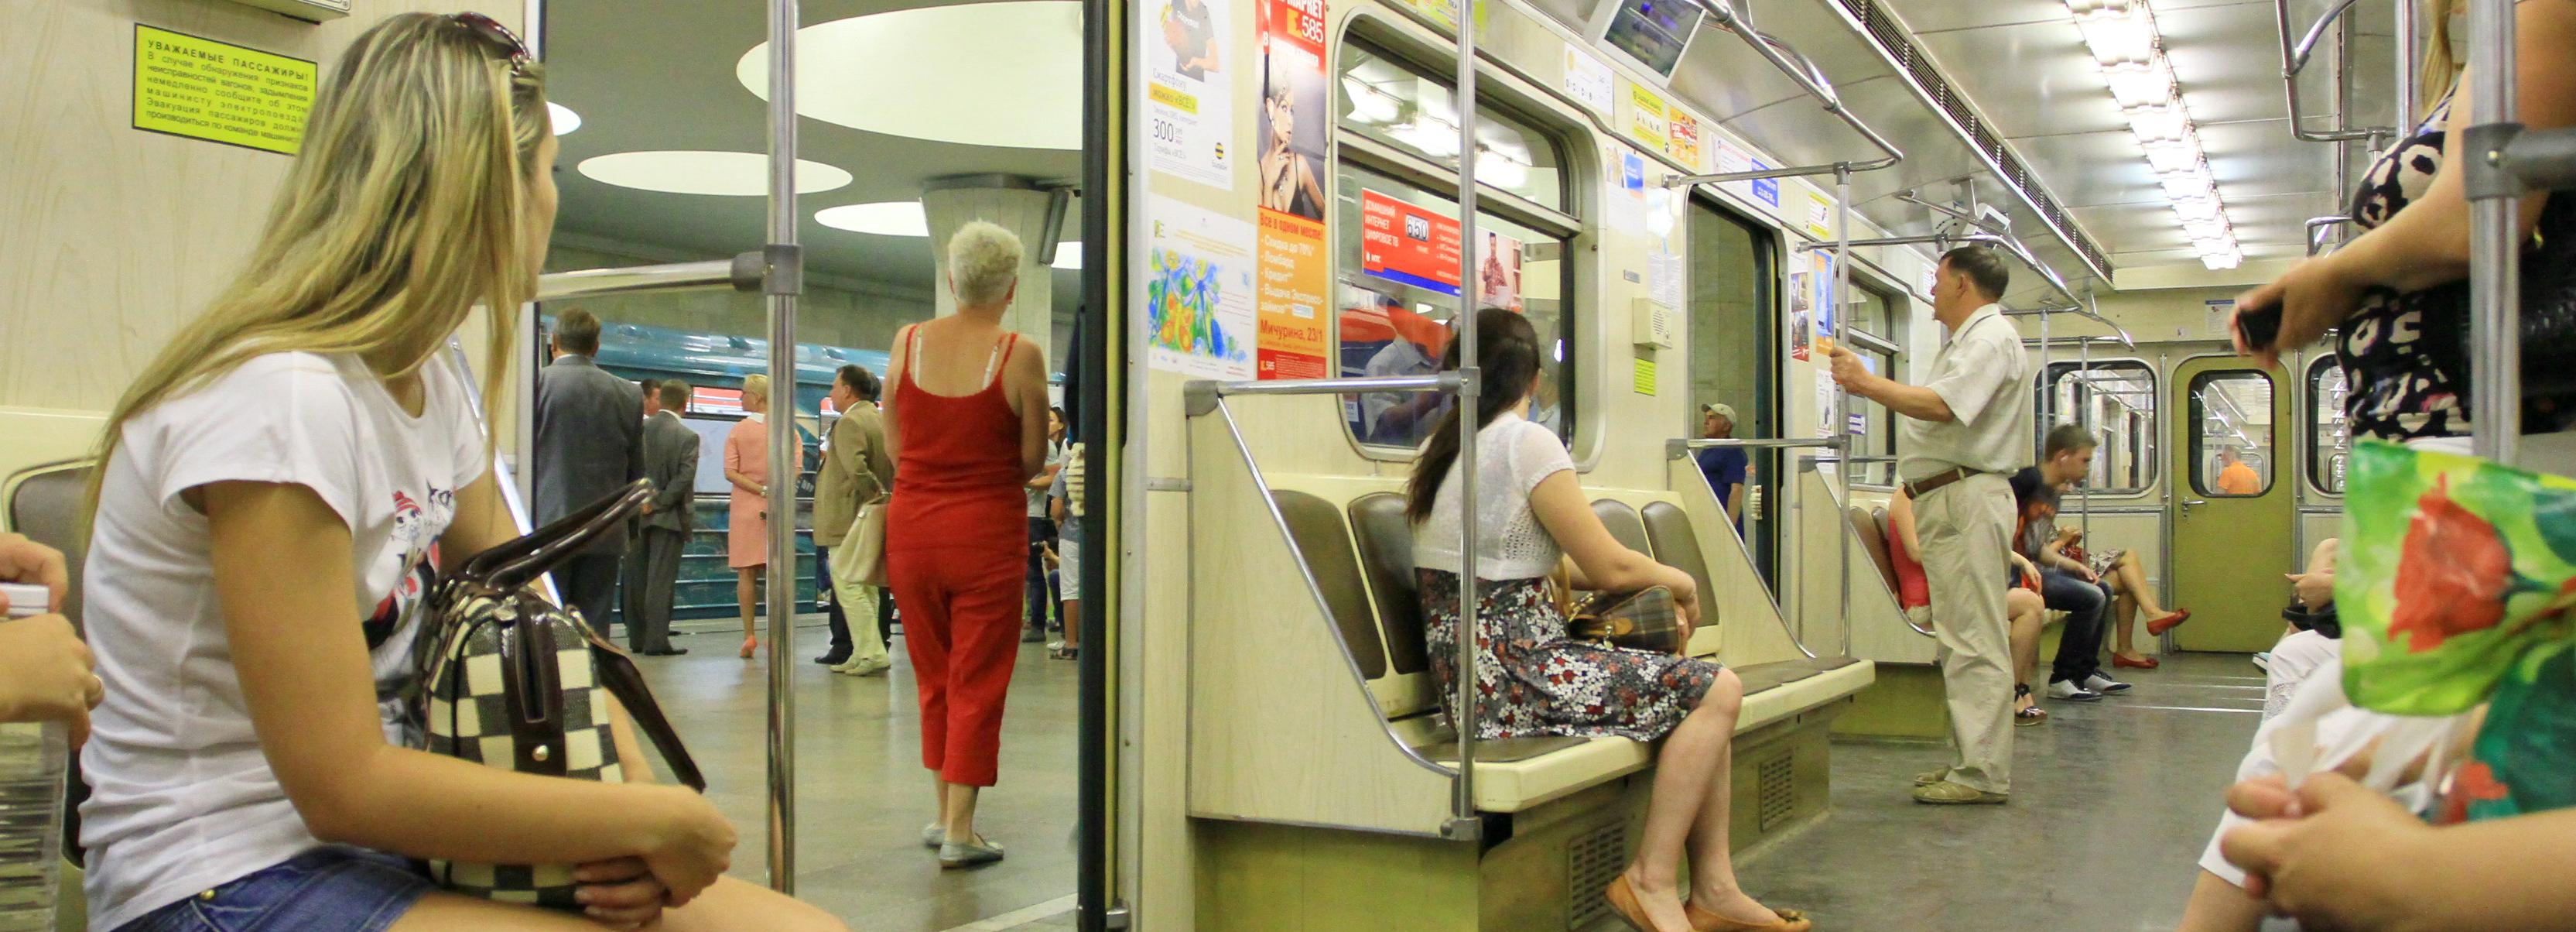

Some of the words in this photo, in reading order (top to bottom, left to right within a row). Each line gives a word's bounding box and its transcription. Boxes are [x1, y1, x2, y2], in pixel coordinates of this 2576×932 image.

[1302, 15, 1324, 43] 585
[148, 40, 224, 63] УВАЖАЕМЫЕ
[233, 59, 308, 81] ПАССАЖИРЫ!
[148, 65, 216, 83] неисправностей
[162, 56, 193, 68] случае
[201, 64, 259, 81] обнаружения
[266, 77, 308, 92] признаков
[147, 88, 211, 107] машинисту
[148, 77, 207, 93] немедленно
[216, 89, 261, 105] сообщите
[269, 99, 279, 108] об
[147, 98, 200, 114] Эвакуация
[209, 110, 265, 127] пассажиров
[147, 110, 210, 127] производиться
[212, 121, 222, 130] по
[224, 124, 258, 137] команде
[1153, 118, 1174, 142] 300
[1407, 217, 1427, 240] 650
[1260, 320, 1305, 340] Мичурина,
